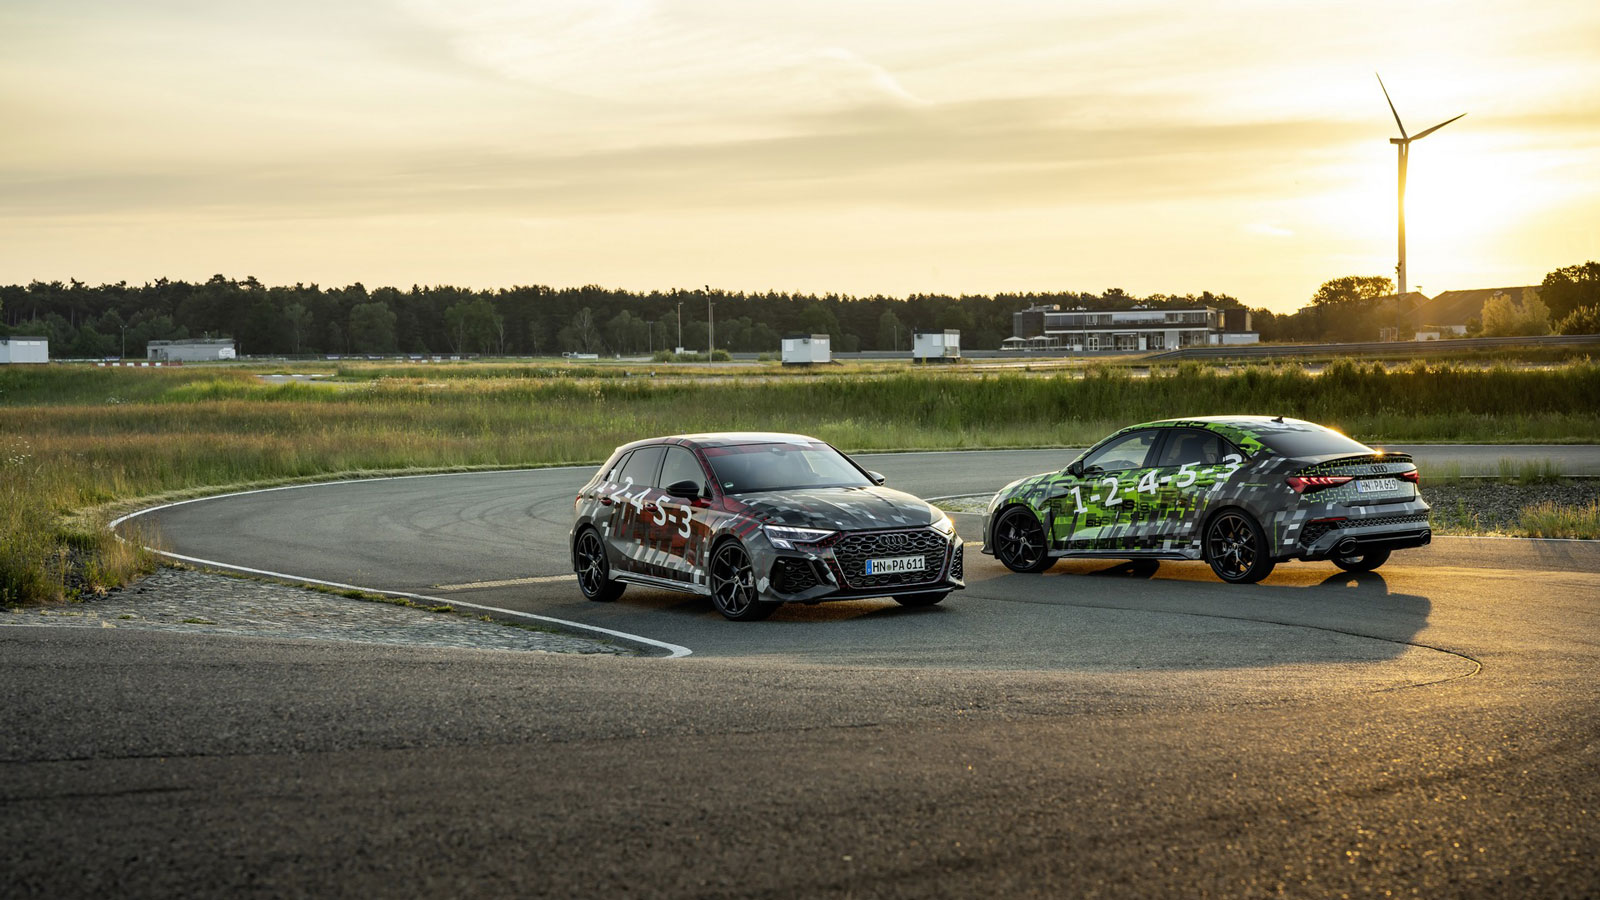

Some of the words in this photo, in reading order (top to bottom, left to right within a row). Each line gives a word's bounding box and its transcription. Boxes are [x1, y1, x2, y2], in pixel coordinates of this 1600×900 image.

[1070, 453, 1243, 514] 1-2-4-5-3
[1361, 481, 1371, 491] HN
[1374, 480, 1384, 490] PA
[1384, 479, 1396, 489] 619
[596, 469, 692, 539] 1-2-4-5-3
[872, 561, 886, 572] HN
[892, 559, 905, 571] PA
[906, 558, 924, 570] 611
